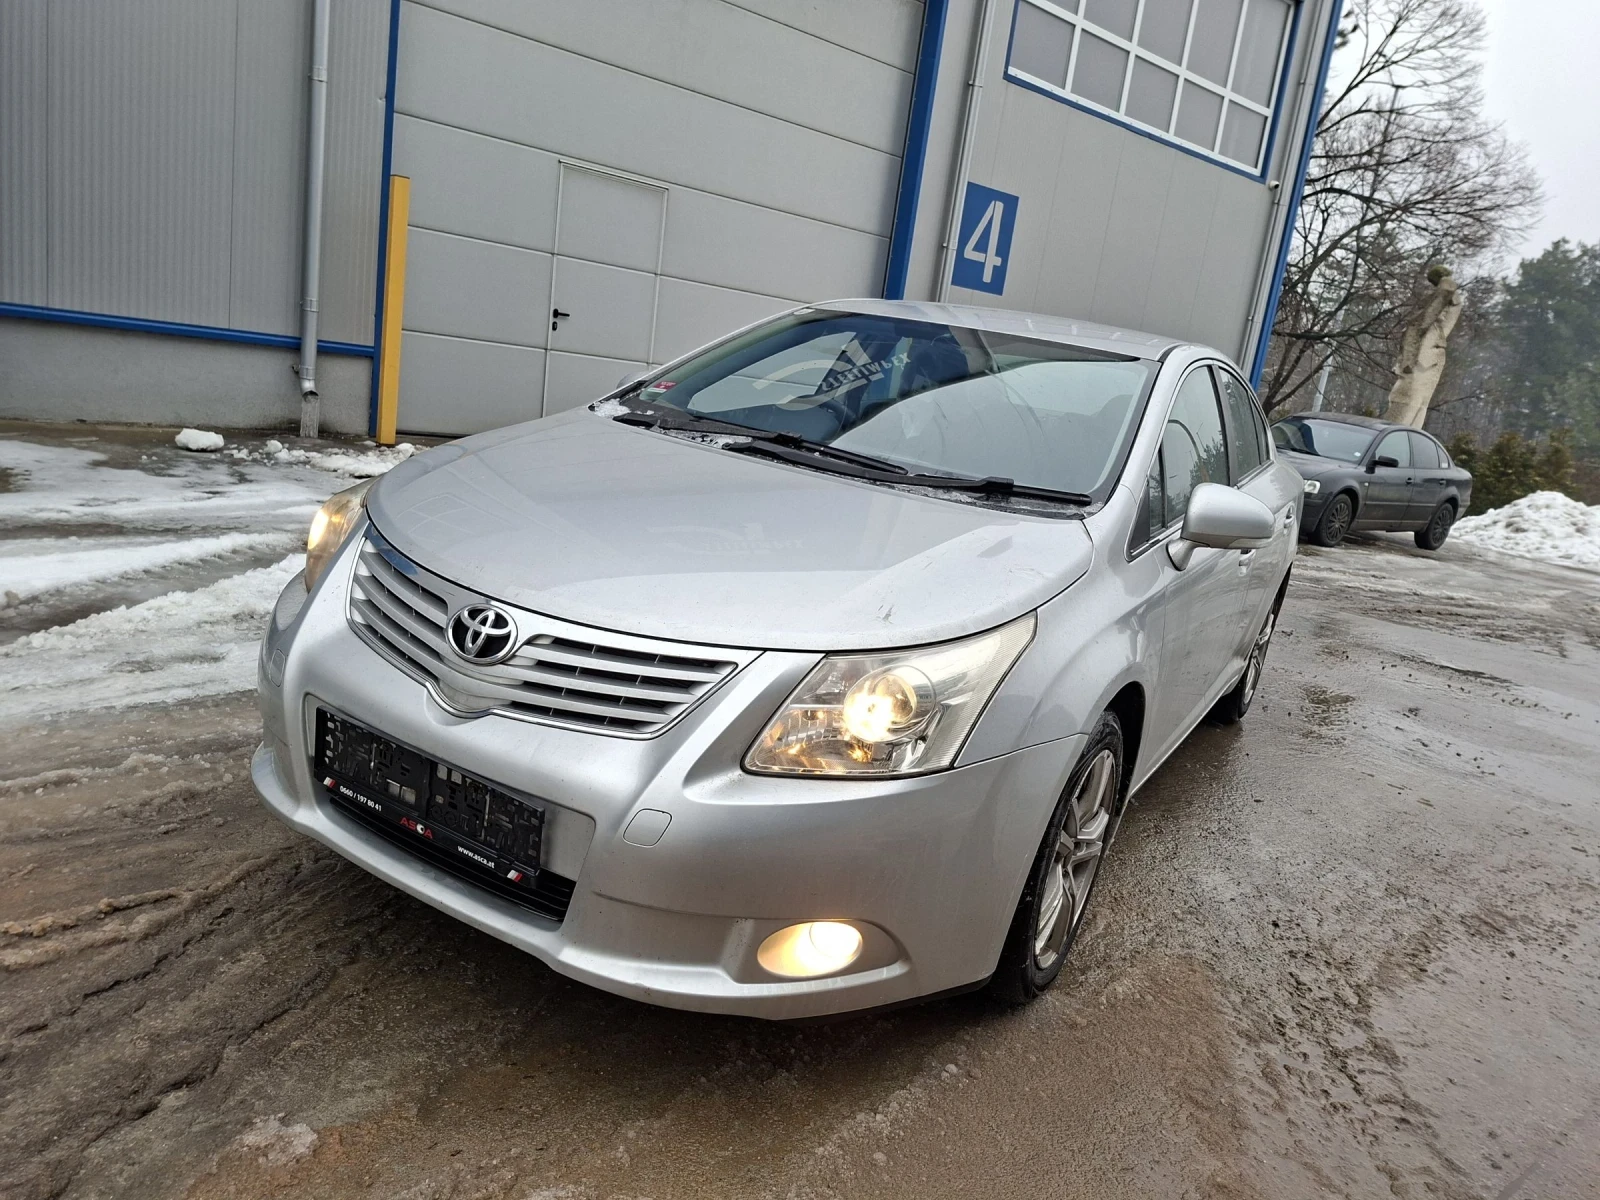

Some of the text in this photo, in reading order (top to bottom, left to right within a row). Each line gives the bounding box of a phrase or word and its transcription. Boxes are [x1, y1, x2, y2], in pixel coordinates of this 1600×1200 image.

[964, 201, 1004, 283] 4
[340, 785, 354, 797] 0660
[357, 794, 367, 803] 197
[367, 799, 375, 808] 80
[375, 803, 382, 812] 41
[400, 817, 433, 839] ASCA
[457, 845, 495, 869] www.asca.at
